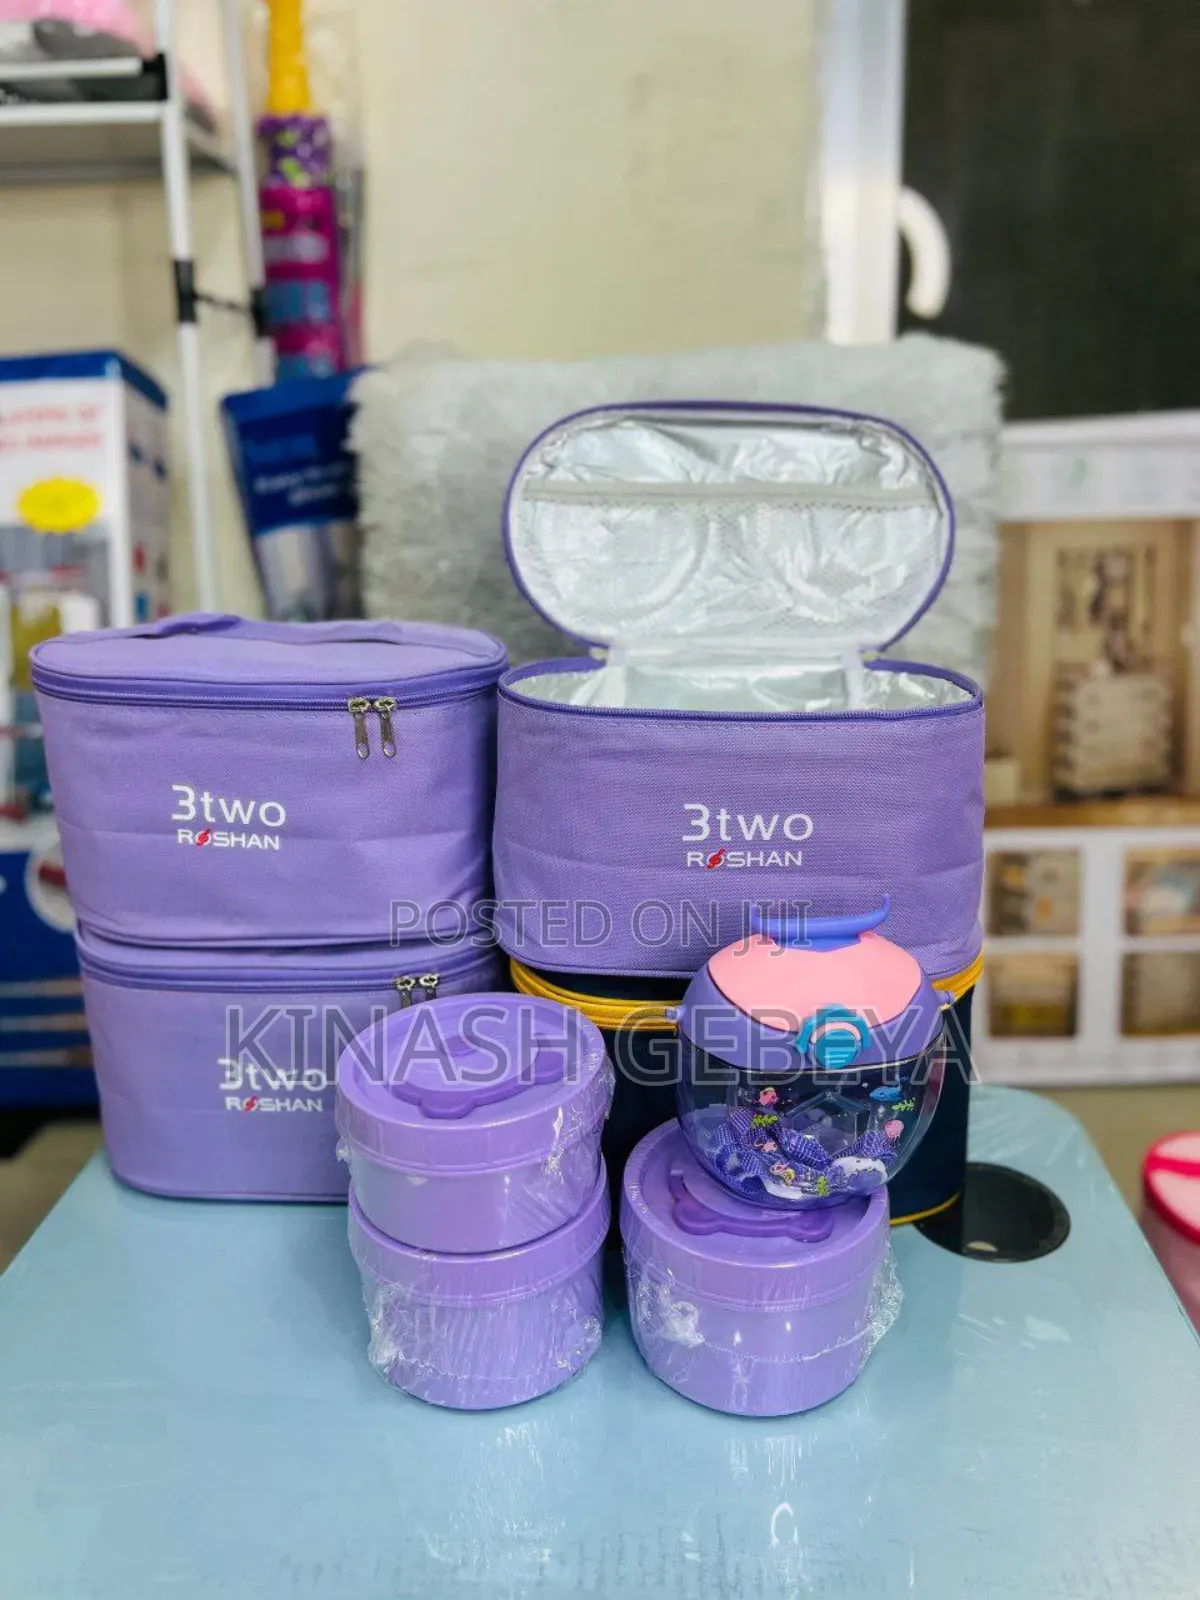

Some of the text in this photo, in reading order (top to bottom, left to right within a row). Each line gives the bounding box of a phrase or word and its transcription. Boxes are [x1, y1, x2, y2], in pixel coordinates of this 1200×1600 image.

[171, 784, 286, 827] 3two
[682, 803, 814, 841] 3two
[177, 828, 280, 850] ROSHAN
[686, 848, 802, 870] ROSHAN
[217, 1058, 327, 1092] 3two
